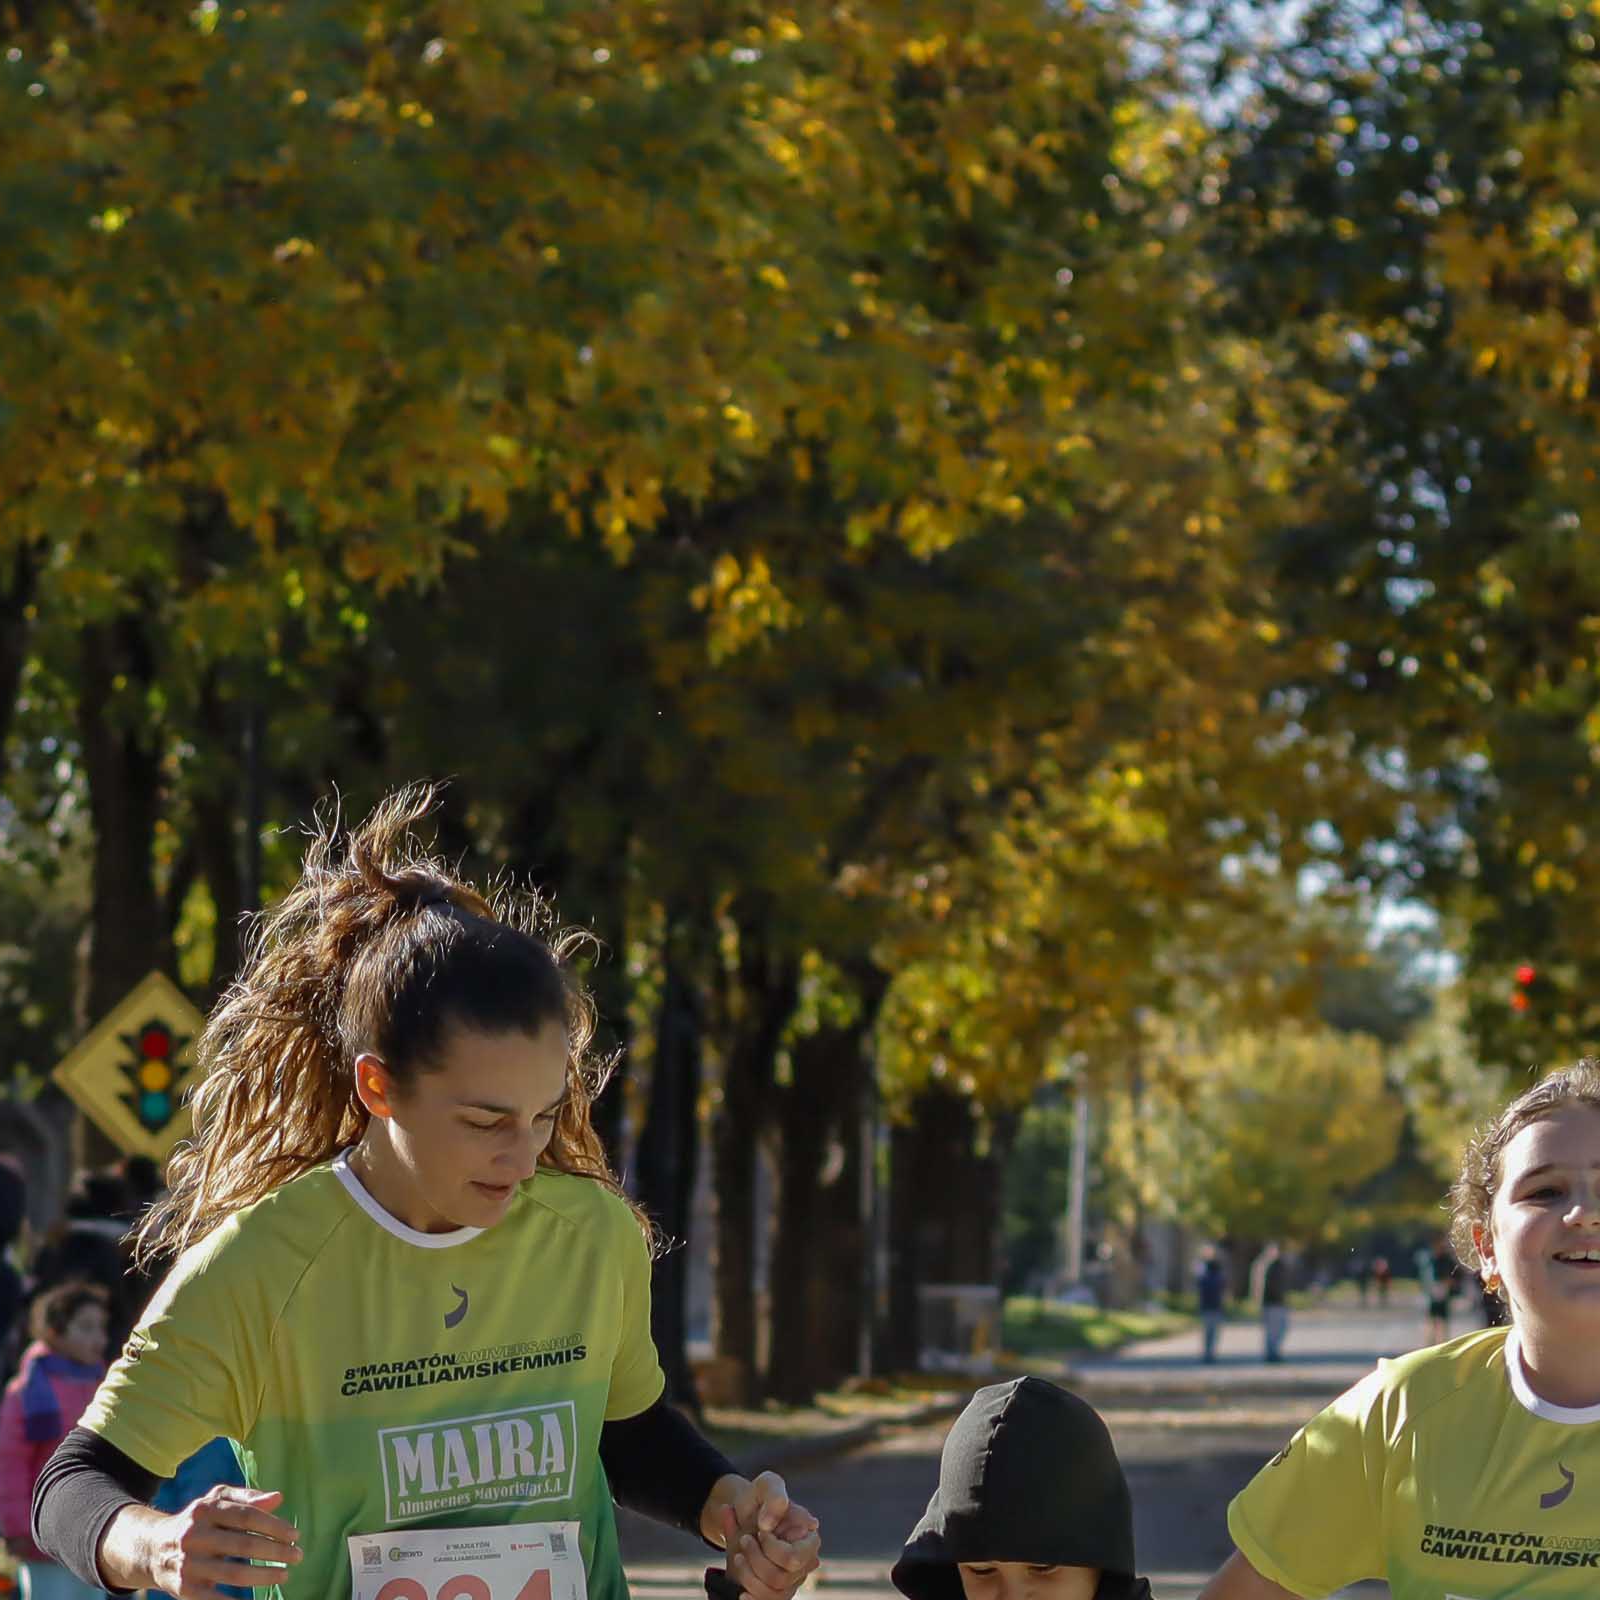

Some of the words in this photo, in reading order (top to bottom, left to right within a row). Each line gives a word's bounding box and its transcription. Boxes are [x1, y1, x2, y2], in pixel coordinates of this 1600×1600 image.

[341, 1345, 587, 1396] CAWILLIAMSKEMMIS
[392, 1413, 566, 1496] MAIRA
[398, 1491, 471, 1517] Almacenes
